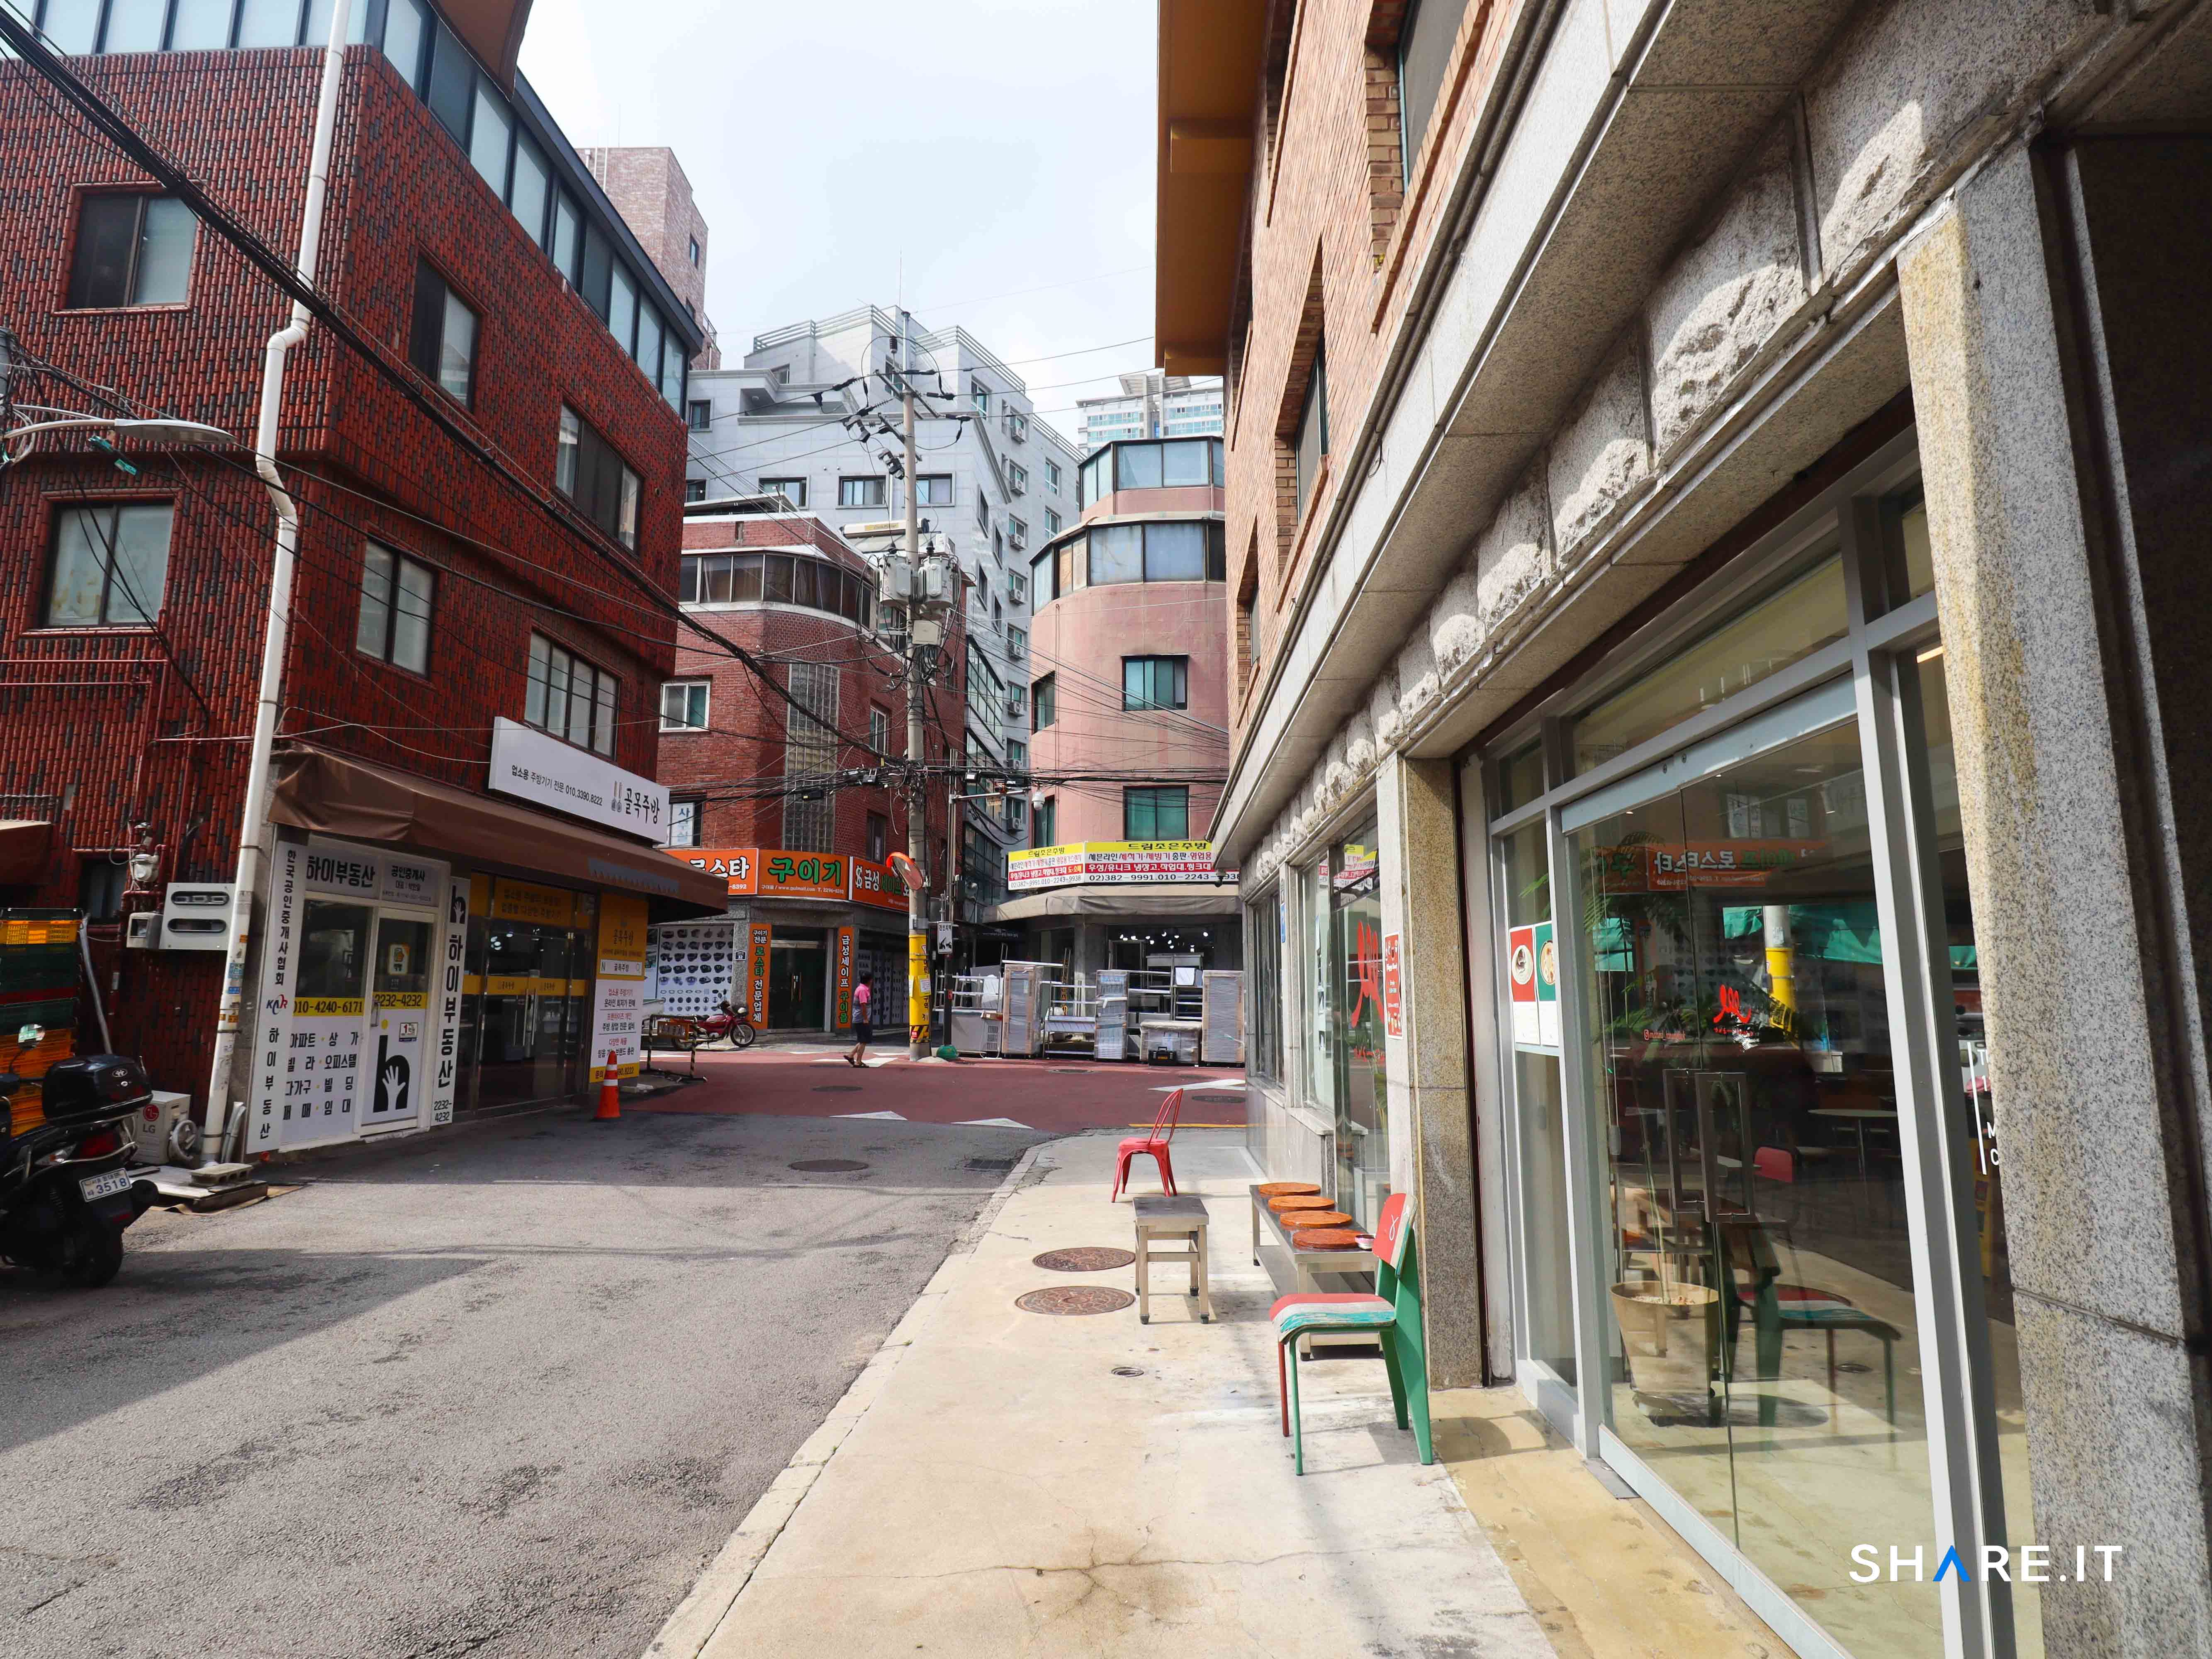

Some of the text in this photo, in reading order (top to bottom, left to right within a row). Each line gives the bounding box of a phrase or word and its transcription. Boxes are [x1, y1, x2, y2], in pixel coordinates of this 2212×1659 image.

[511, 764, 603, 806] 업소용 주방기기 전문 010.3390.8222
[624, 788, 660, 824] 골목주방
[1028, 847, 1065, 857] 드림조은주방
[1089, 853, 1118, 861] 세븐라인
[1128, 842, 1207, 850] 드림조은주방
[306, 856, 375, 888] 하이부동산
[392, 865, 425, 881] 공인중개사
[768, 857, 842, 886] 구이기
[864, 869, 879, 892] 금성
[754, 947, 764, 976] 로스타
[840, 935, 850, 988] 금성세이프
[375, 994, 422, 1007] 2232-4232
[438, 934, 463, 1088] 하이부동산
[753, 980, 763, 1022] 전문업체
[324, 1054, 357, 1070] 오피스텔
[260, 1028, 280, 1139] 하이부동산
[435, 1112, 450, 1121] 4232
[142, 1124, 156, 1134] LG
[96, 1178, 127, 1194] 3518
